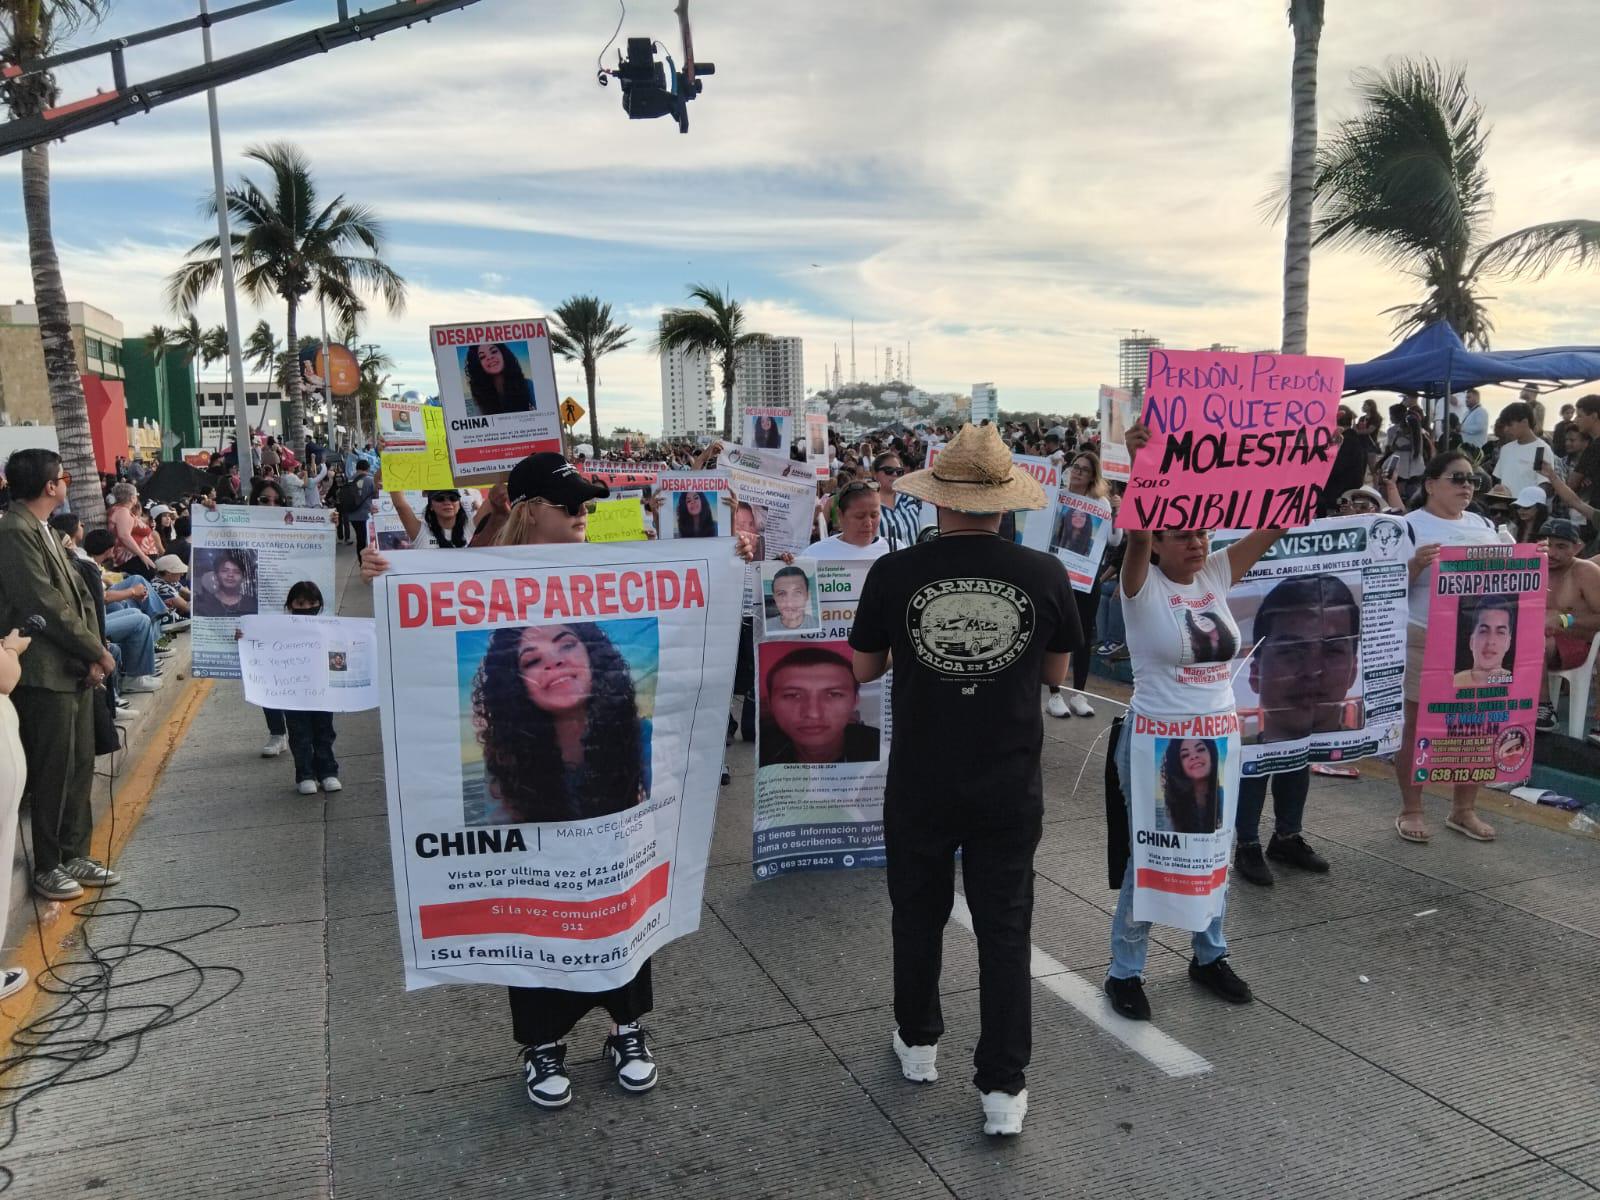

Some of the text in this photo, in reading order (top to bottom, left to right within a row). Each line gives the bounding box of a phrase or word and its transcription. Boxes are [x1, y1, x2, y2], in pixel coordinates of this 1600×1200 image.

[436, 322, 546, 347] DESAPARECIDA
[745, 407, 793, 417] DESAPARECIDA
[1144, 393, 1326, 434] NO QUIERO
[451, 417, 489, 431] CHINA
[1159, 425, 1332, 475] MOLESTAR
[661, 478, 729, 491] DESAPARECIDA
[1057, 493, 1112, 520] ESAPARECID
[221, 513, 250, 524] Sinaloa
[251, 540, 295, 549] CASTAÑEDA
[296, 542, 322, 550] FLORES
[1280, 532, 1358, 555] VISTO A?
[1466, 546, 1513, 559] COLECTIVO
[1242, 558, 1372, 578] ANUEL CARRIZALES MONTES DE OCA
[819, 579, 852, 593] naloa
[1437, 572, 1541, 595] DESAPARECIDO
[398, 568, 705, 629] DESAPARECIDA
[912, 580, 1029, 613] CARNAVAL
[912, 628, 965, 672] SINALOA
[986, 630, 1031, 670] LINEA
[1431, 768, 1451, 781] 638
[1454, 768, 1470, 781] 113
[556, 828, 594, 838] MARIA
[614, 821, 643, 841] FLORES
[757, 834, 766, 843] Si
[768, 829, 796, 839] tienes
[800, 825, 857, 836] información
[1136, 830, 1181, 849] CHINA
[415, 828, 528, 858] CHINA
[757, 842, 780, 854] llama
[847, 835, 859, 843] Tu
[861, 834, 884, 845] ayud
[448, 870, 481, 880] Vista
[485, 867, 507, 878] por
[511, 866, 550, 877] ultima
[554, 870, 576, 878] vez
[580, 867, 592, 878] el
[595, 866, 608, 875] 21
[611, 861, 625, 871] de
[626, 851, 641, 868] julio
[780, 857, 834, 869] 669 327 8424
[468, 881, 488, 889] av.
[491, 879, 503, 887] la
[507, 877, 550, 887] piedad
[553, 881, 583, 891] 4205
[587, 868, 634, 888] Mazatlán
[492, 895, 637, 919] Si la vez comunicate al
[561, 922, 585, 931] 911
[431, 912, 661, 966] ¡Su familia la extraña mucho!
